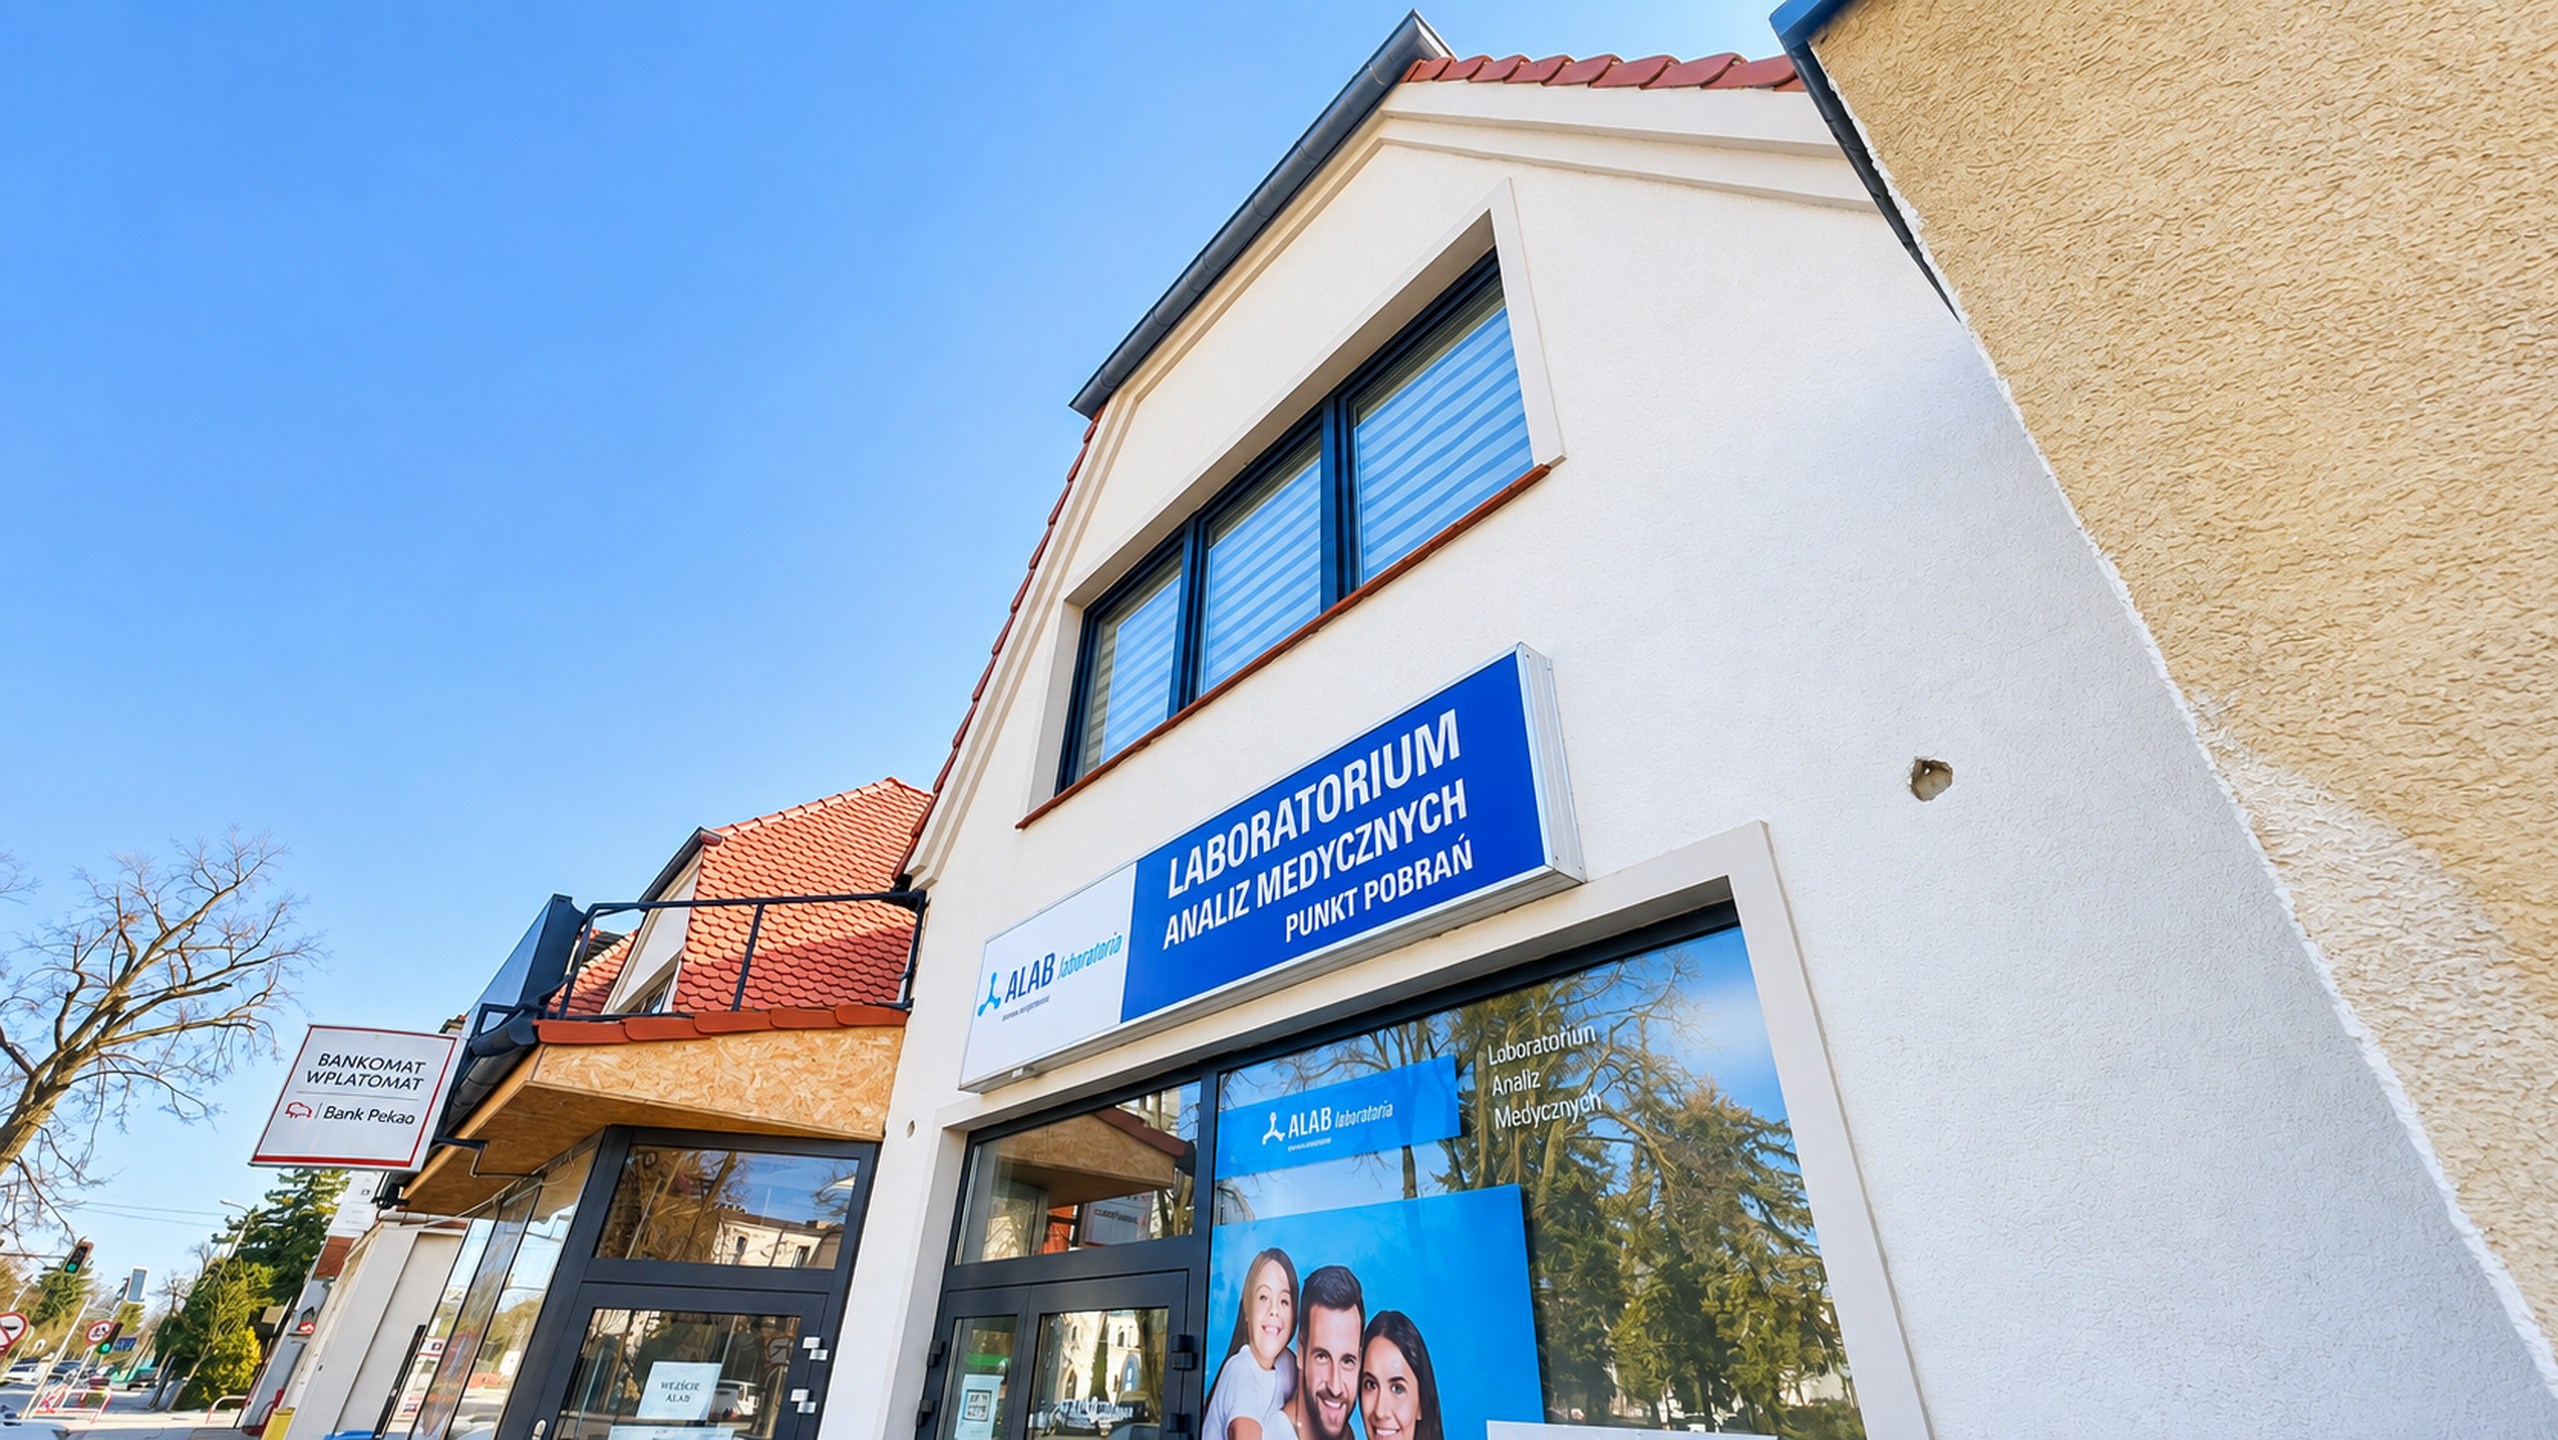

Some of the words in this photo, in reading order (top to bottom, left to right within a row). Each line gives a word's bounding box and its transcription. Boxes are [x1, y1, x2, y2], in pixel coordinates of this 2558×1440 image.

[1168, 708, 1461, 899] LABORATORIUM
[1162, 879, 1250, 950] ANALIZ
[1256, 778, 1468, 909] MEDYCZNYCH
[1286, 887, 1358, 943] PUNKT
[1363, 833, 1474, 910] POBRAŃ
[1004, 952, 1056, 1004] ALAB
[1057, 931, 1123, 980] laboratoria
[306, 1070, 424, 1091] WPLATOMAT
[317, 1053, 426, 1075] BANKOMAT
[323, 1105, 364, 1121] Bank
[367, 1108, 415, 1125] Pekao
[1288, 1106, 1332, 1139] ALAB
[1494, 1088, 1601, 1130] Medycznych
